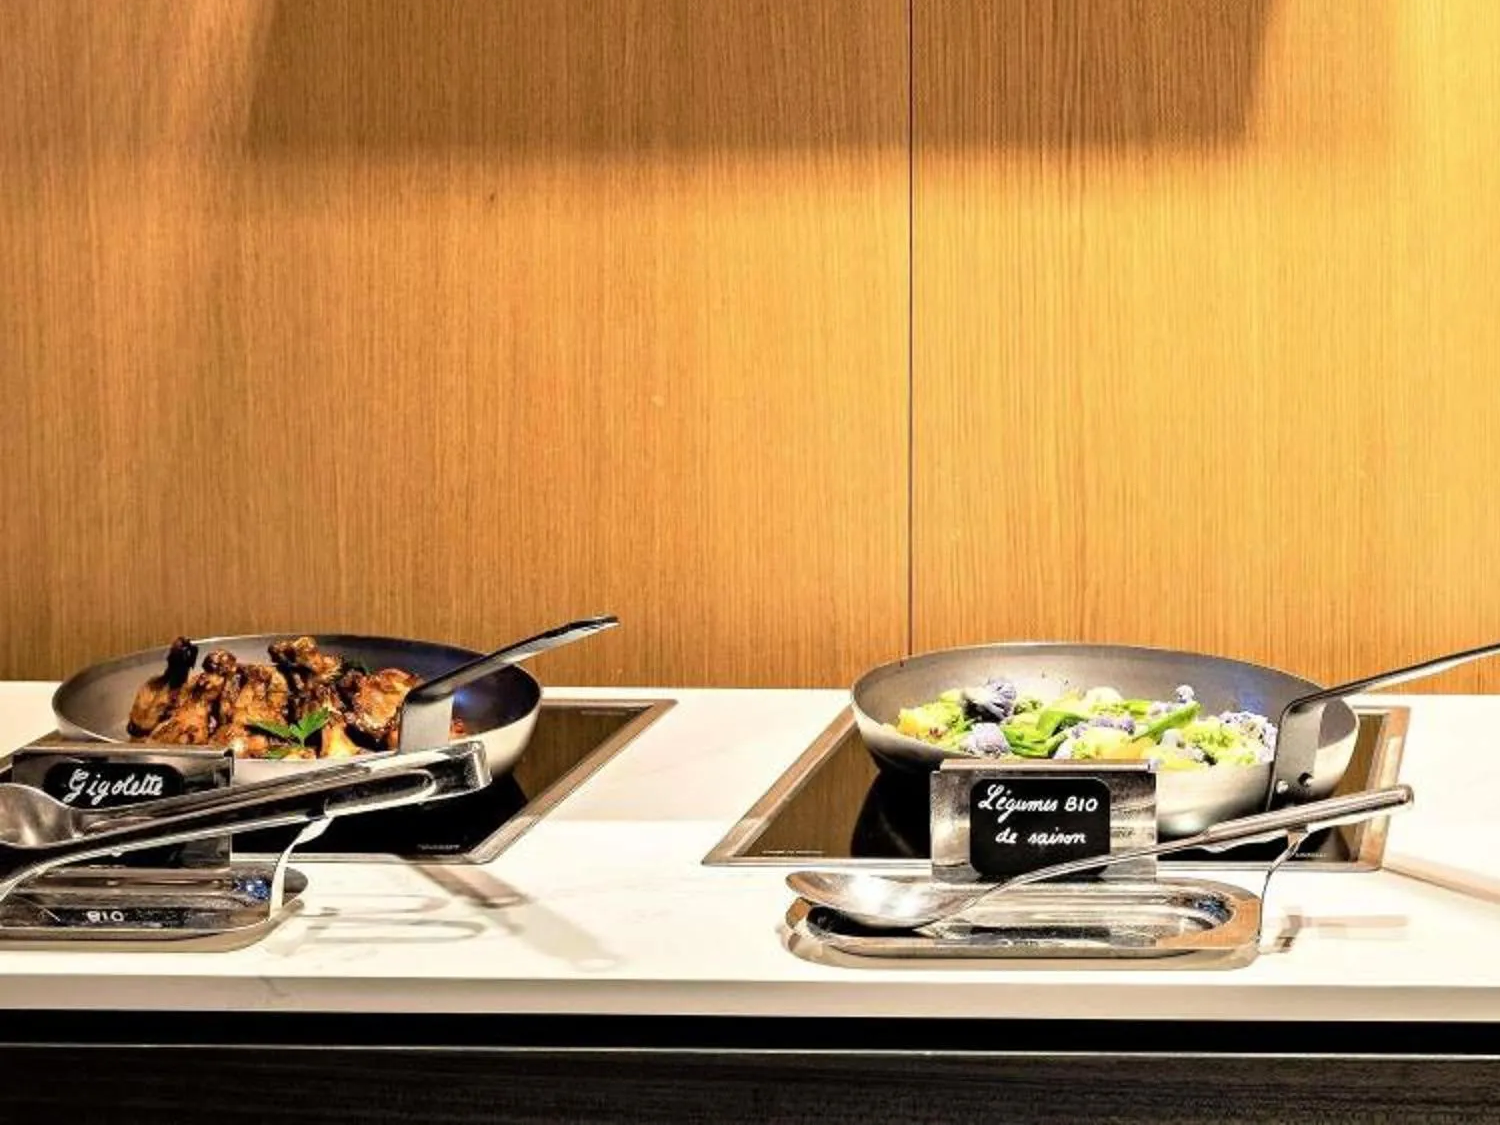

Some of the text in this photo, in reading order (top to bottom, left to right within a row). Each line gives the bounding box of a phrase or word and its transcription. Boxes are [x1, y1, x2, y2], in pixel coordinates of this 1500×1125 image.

[62, 768, 164, 806] Gigolette
[977, 783, 1099, 824] Légumes BIO
[995, 827, 1087, 846] de saison
